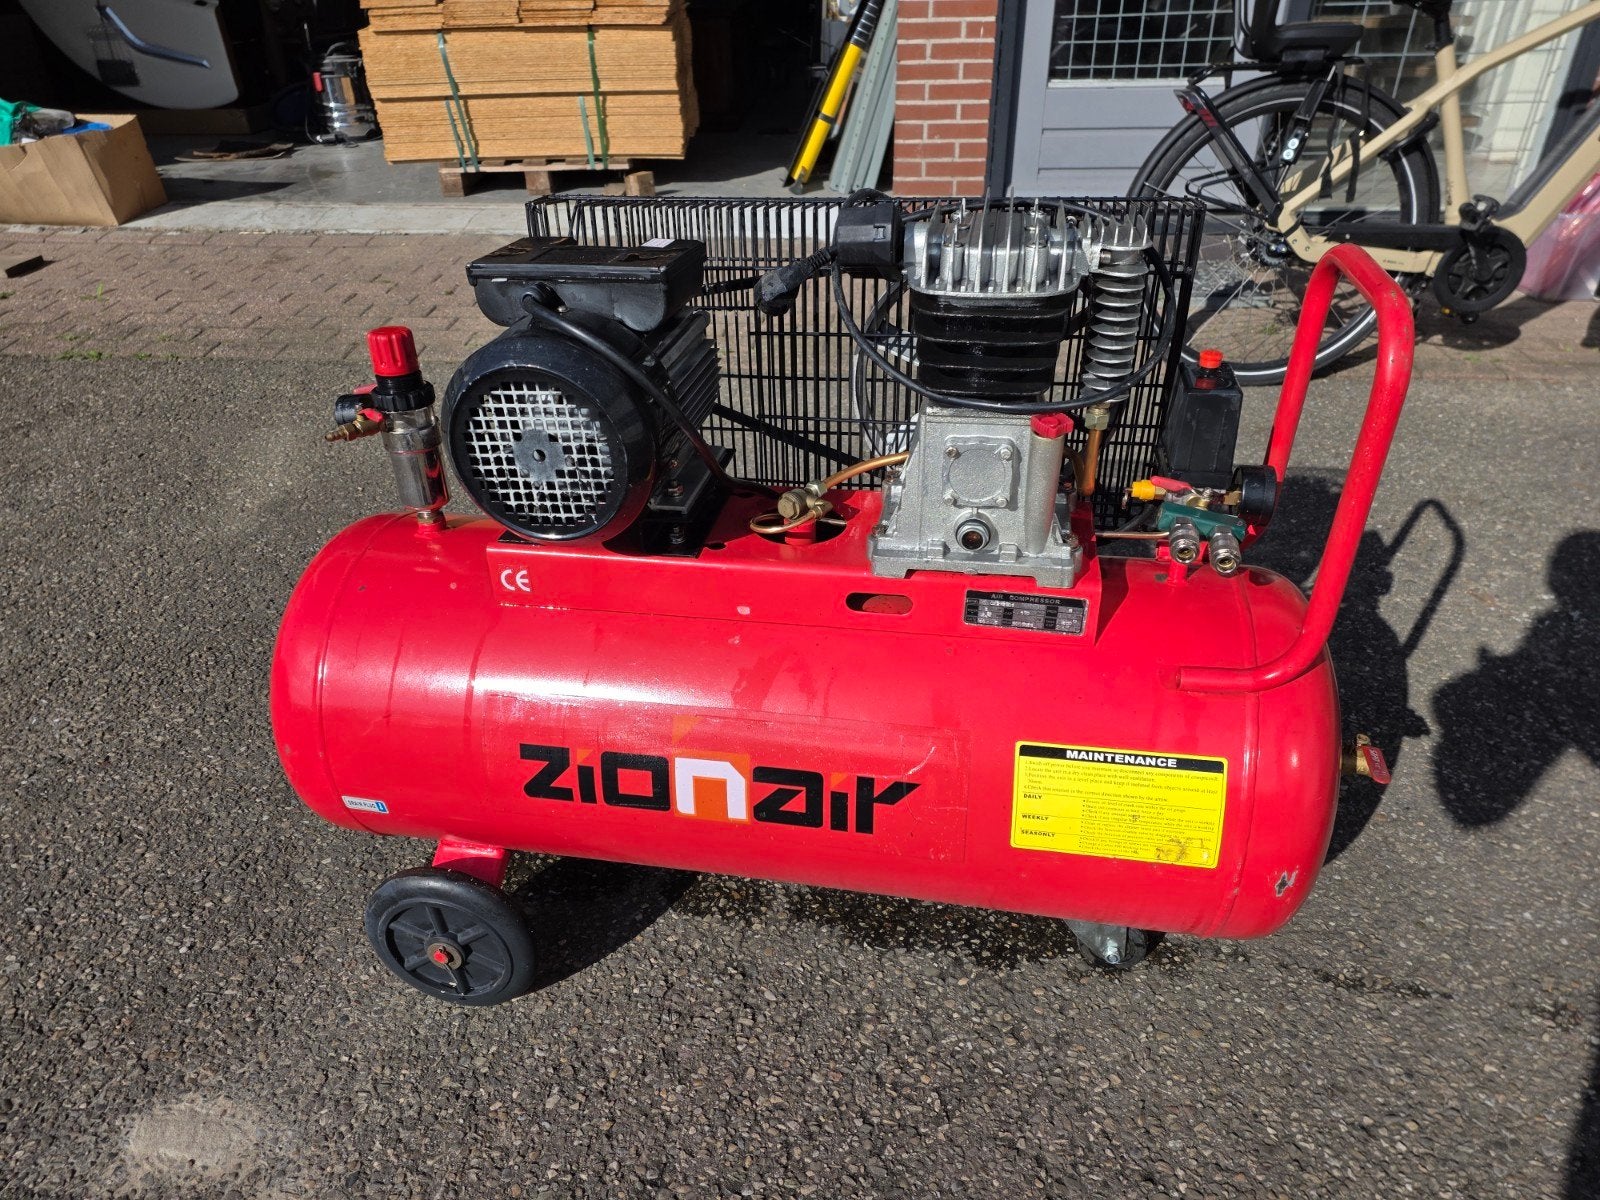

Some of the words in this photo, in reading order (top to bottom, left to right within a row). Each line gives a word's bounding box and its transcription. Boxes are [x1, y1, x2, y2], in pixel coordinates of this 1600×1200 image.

[500, 568, 531, 592] CE
[1009, 595, 1062, 605] COMPRESSOR
[1065, 750, 1178, 768] MAINTENANCE
[1023, 794, 1043, 802] DAILY
